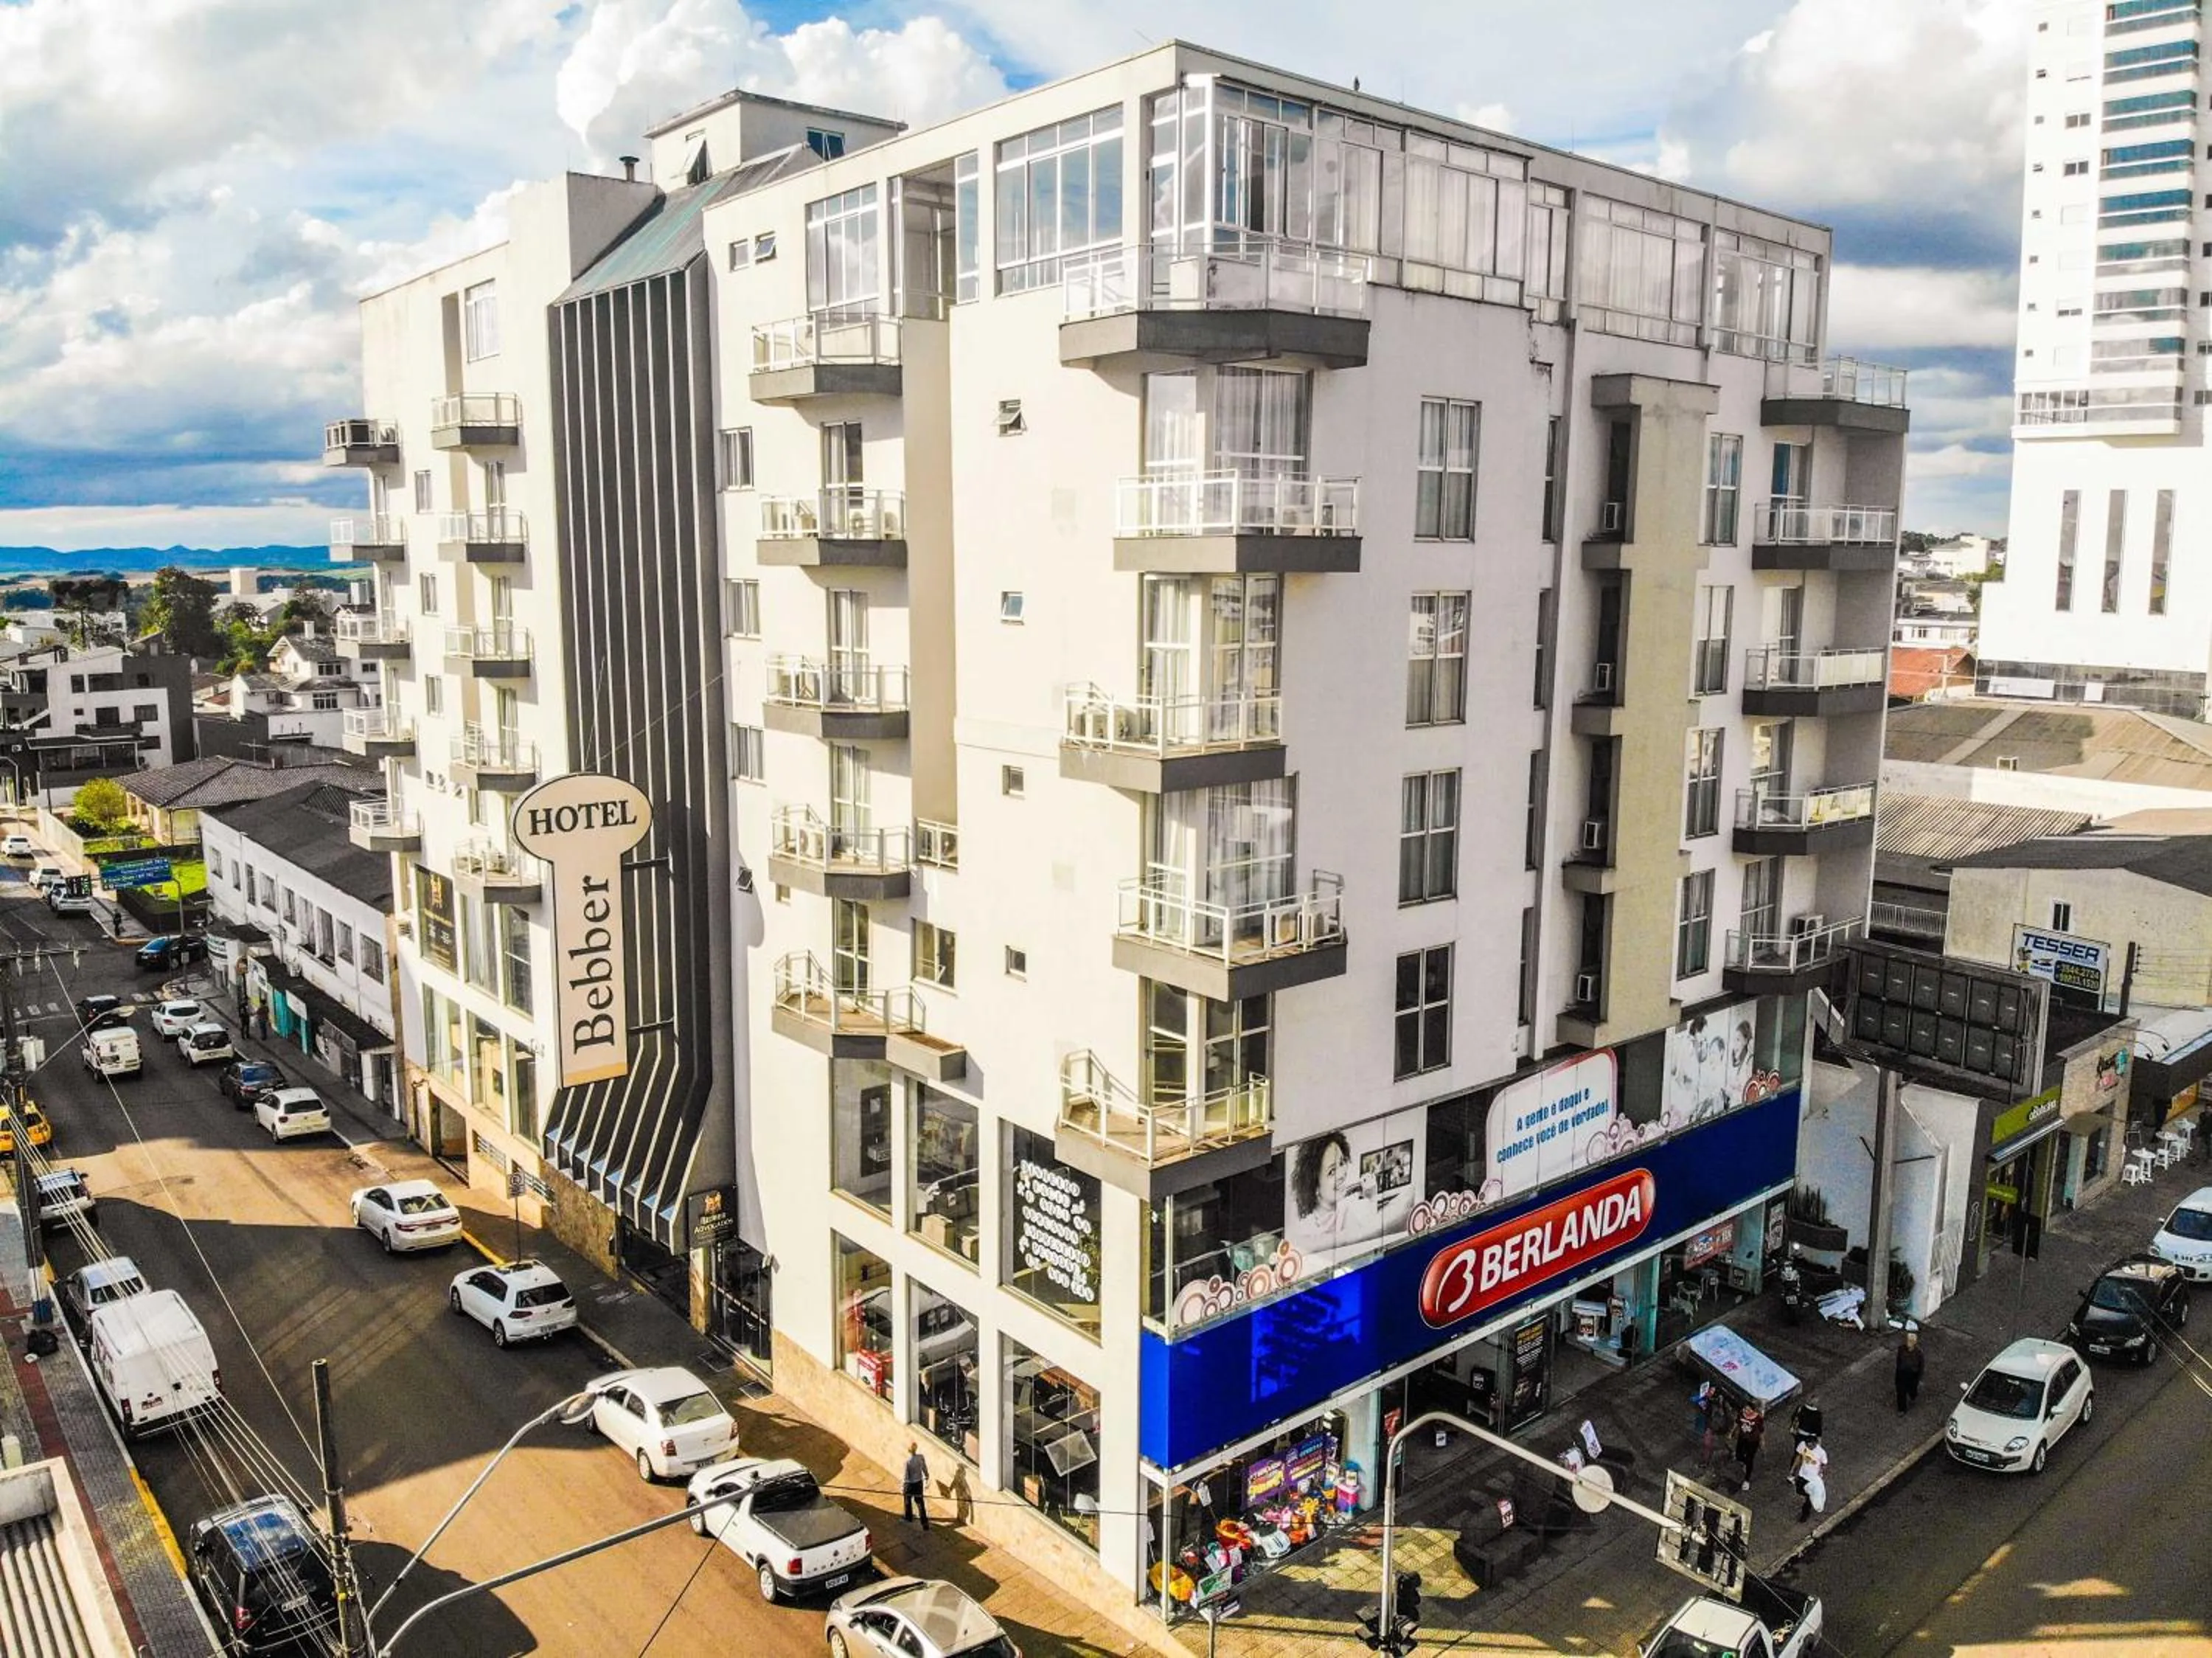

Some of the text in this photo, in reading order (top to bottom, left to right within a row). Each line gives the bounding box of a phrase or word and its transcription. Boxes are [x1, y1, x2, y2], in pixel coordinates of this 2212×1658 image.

[528, 800, 638, 836] HOTEL
[568, 875, 615, 1055] Bebber
[2023, 932, 2100, 962] TESSER
[1517, 1117, 1523, 1132] A
[1525, 1106, 1549, 1129] gente
[1558, 1090, 1582, 1112] daqui
[1584, 1087, 1590, 1100] e
[1497, 1136, 1534, 1163] conhece
[1536, 1123, 1557, 1145] você
[1558, 1118, 1570, 1134] de
[1479, 1184, 1641, 1293] BERLANDA
